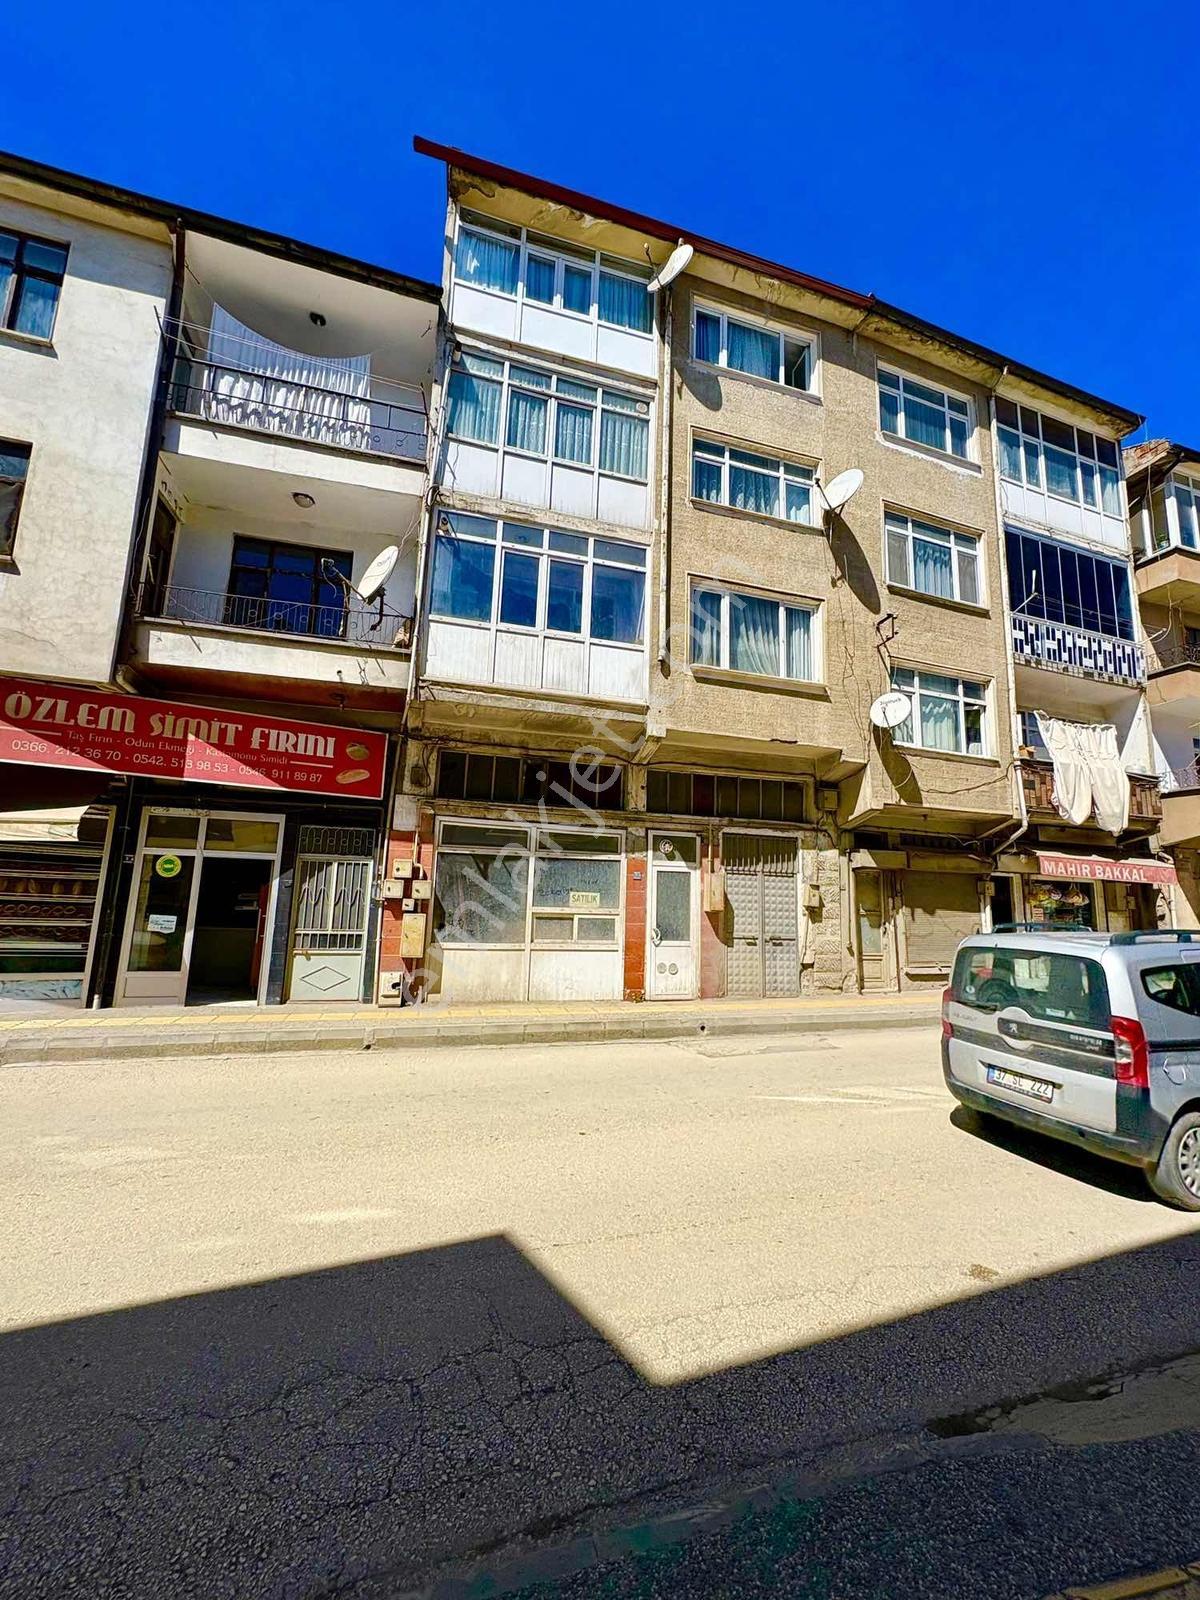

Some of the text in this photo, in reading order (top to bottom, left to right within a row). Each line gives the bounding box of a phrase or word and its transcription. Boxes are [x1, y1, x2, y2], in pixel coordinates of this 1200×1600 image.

[4, 690, 336, 758] ÖZLEM SİMİT FIRINI
[125, 737, 155, 748] Odun
[84, 747, 101, 759] 36
[106, 750, 122, 760] 70
[196, 760, 211, 770] 98
[213, 763, 229, 773] 53
[271, 769, 290, 780] 911
[293, 771, 307, 781] 89
[309, 771, 323, 783] 87
[1044, 860, 1148, 881] MAHIR BAKKAL
[571, 894, 599, 905] SATILIK
[995, 1070, 1007, 1081] 37
[1030, 1080, 1050, 1096] 222
